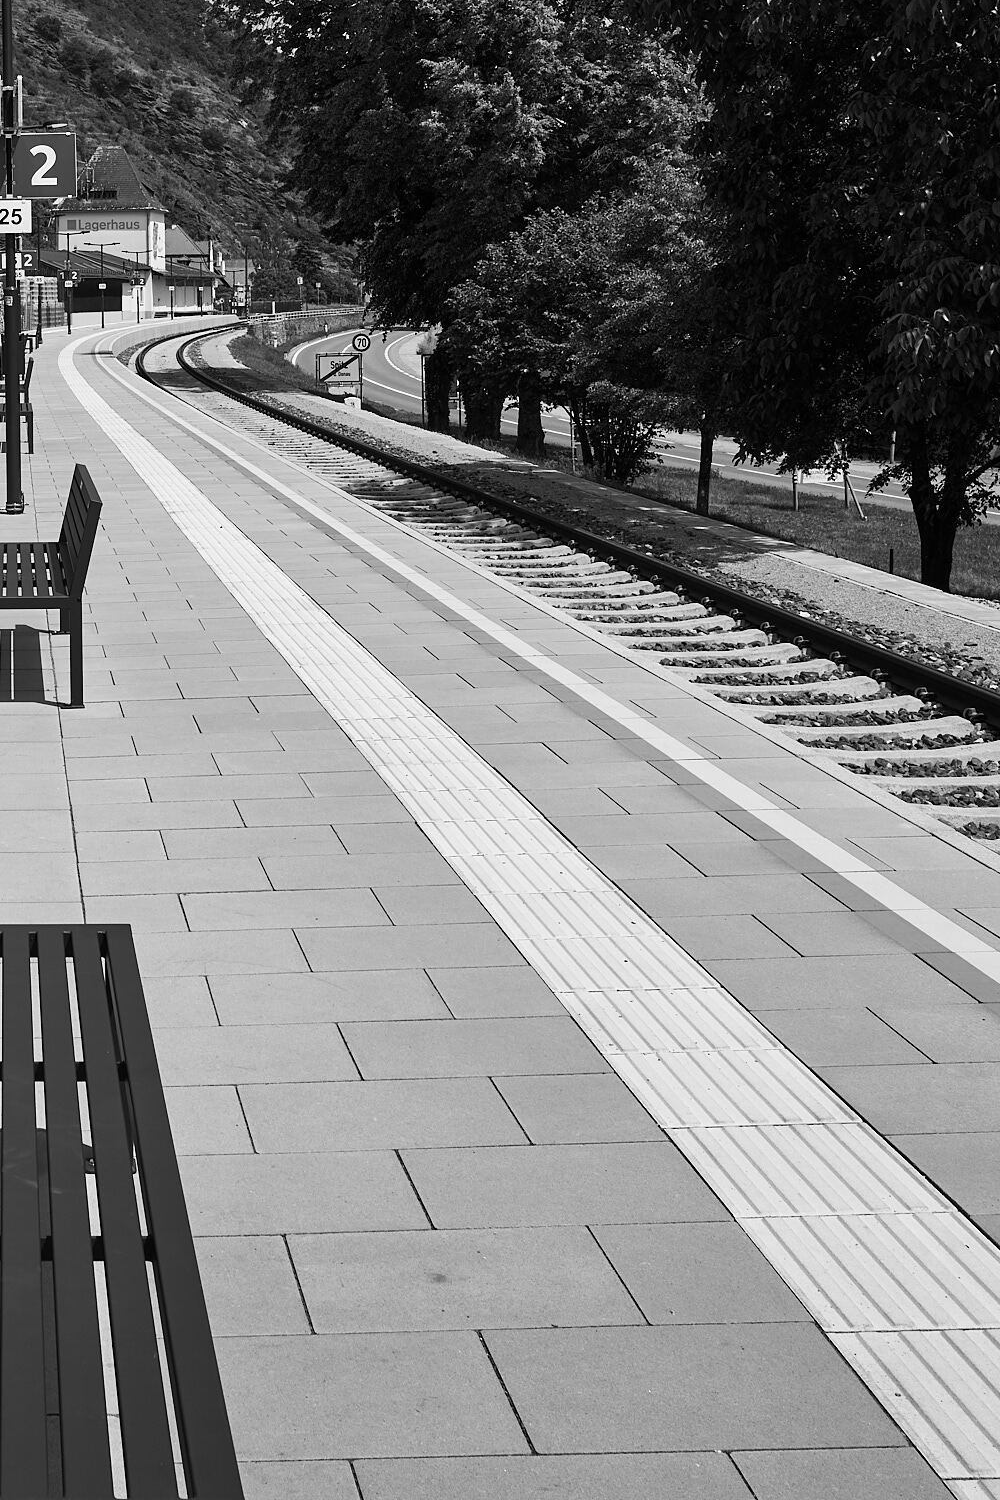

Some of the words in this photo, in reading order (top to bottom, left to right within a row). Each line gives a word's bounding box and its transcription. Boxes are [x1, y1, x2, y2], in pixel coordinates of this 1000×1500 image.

[29, 144, 58, 186] 2
[78, 219, 140, 231] Lagerhaus
[23, 253, 33, 267] 2
[59, 272, 65, 280] 1
[71, 271, 78, 280] 2
[357, 338, 367, 348] 70
